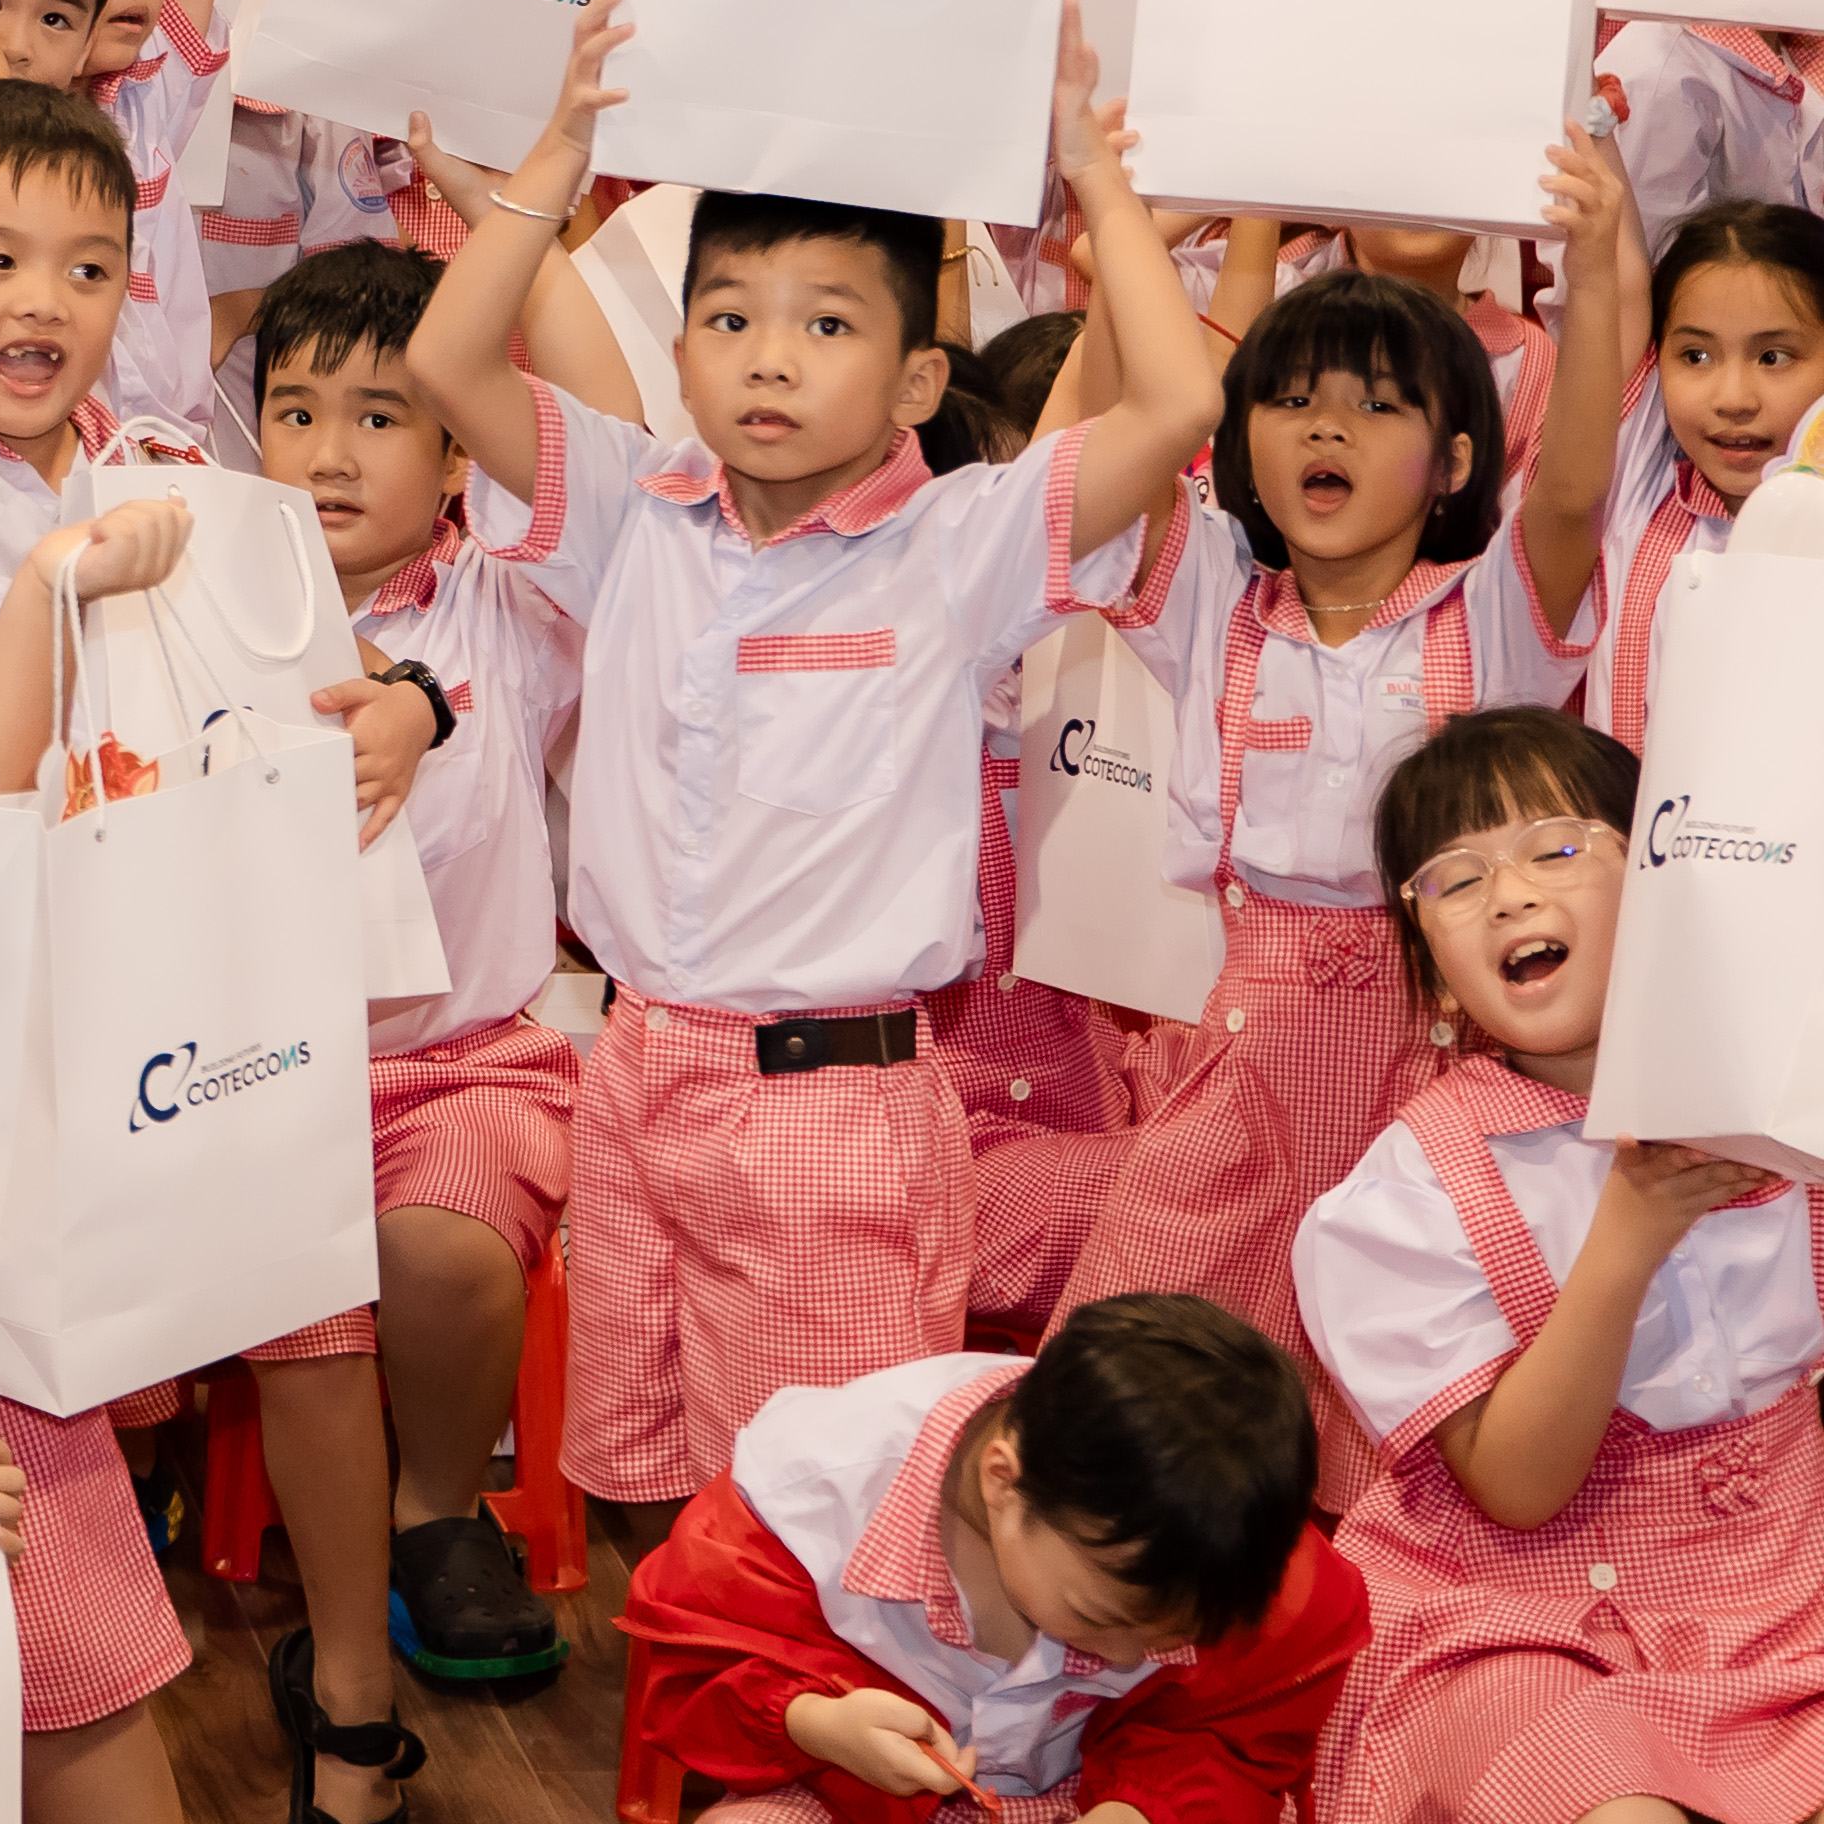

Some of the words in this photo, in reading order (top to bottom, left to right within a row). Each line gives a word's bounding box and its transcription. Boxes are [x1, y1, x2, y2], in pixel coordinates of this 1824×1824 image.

[1084, 754, 1151, 793] COTECCONS
[1672, 836, 1797, 863] COTECCONS
[187, 1042, 310, 1105] COTECCONS
